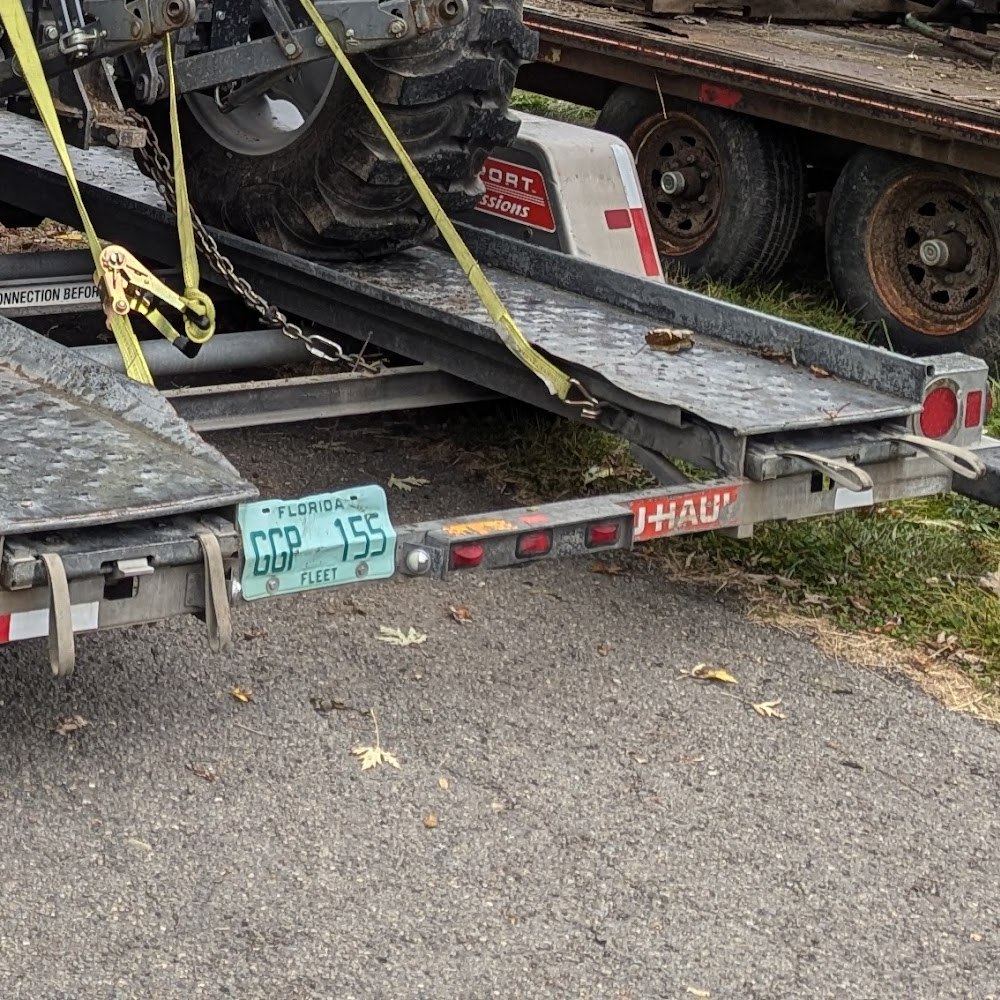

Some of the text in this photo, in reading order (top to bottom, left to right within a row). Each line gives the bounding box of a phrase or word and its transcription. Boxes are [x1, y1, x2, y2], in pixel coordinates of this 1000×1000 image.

[278, 497, 345, 518] FLORIDA
[250, 512, 387, 576] GGP 155
[300, 567, 338, 585] FLEET
